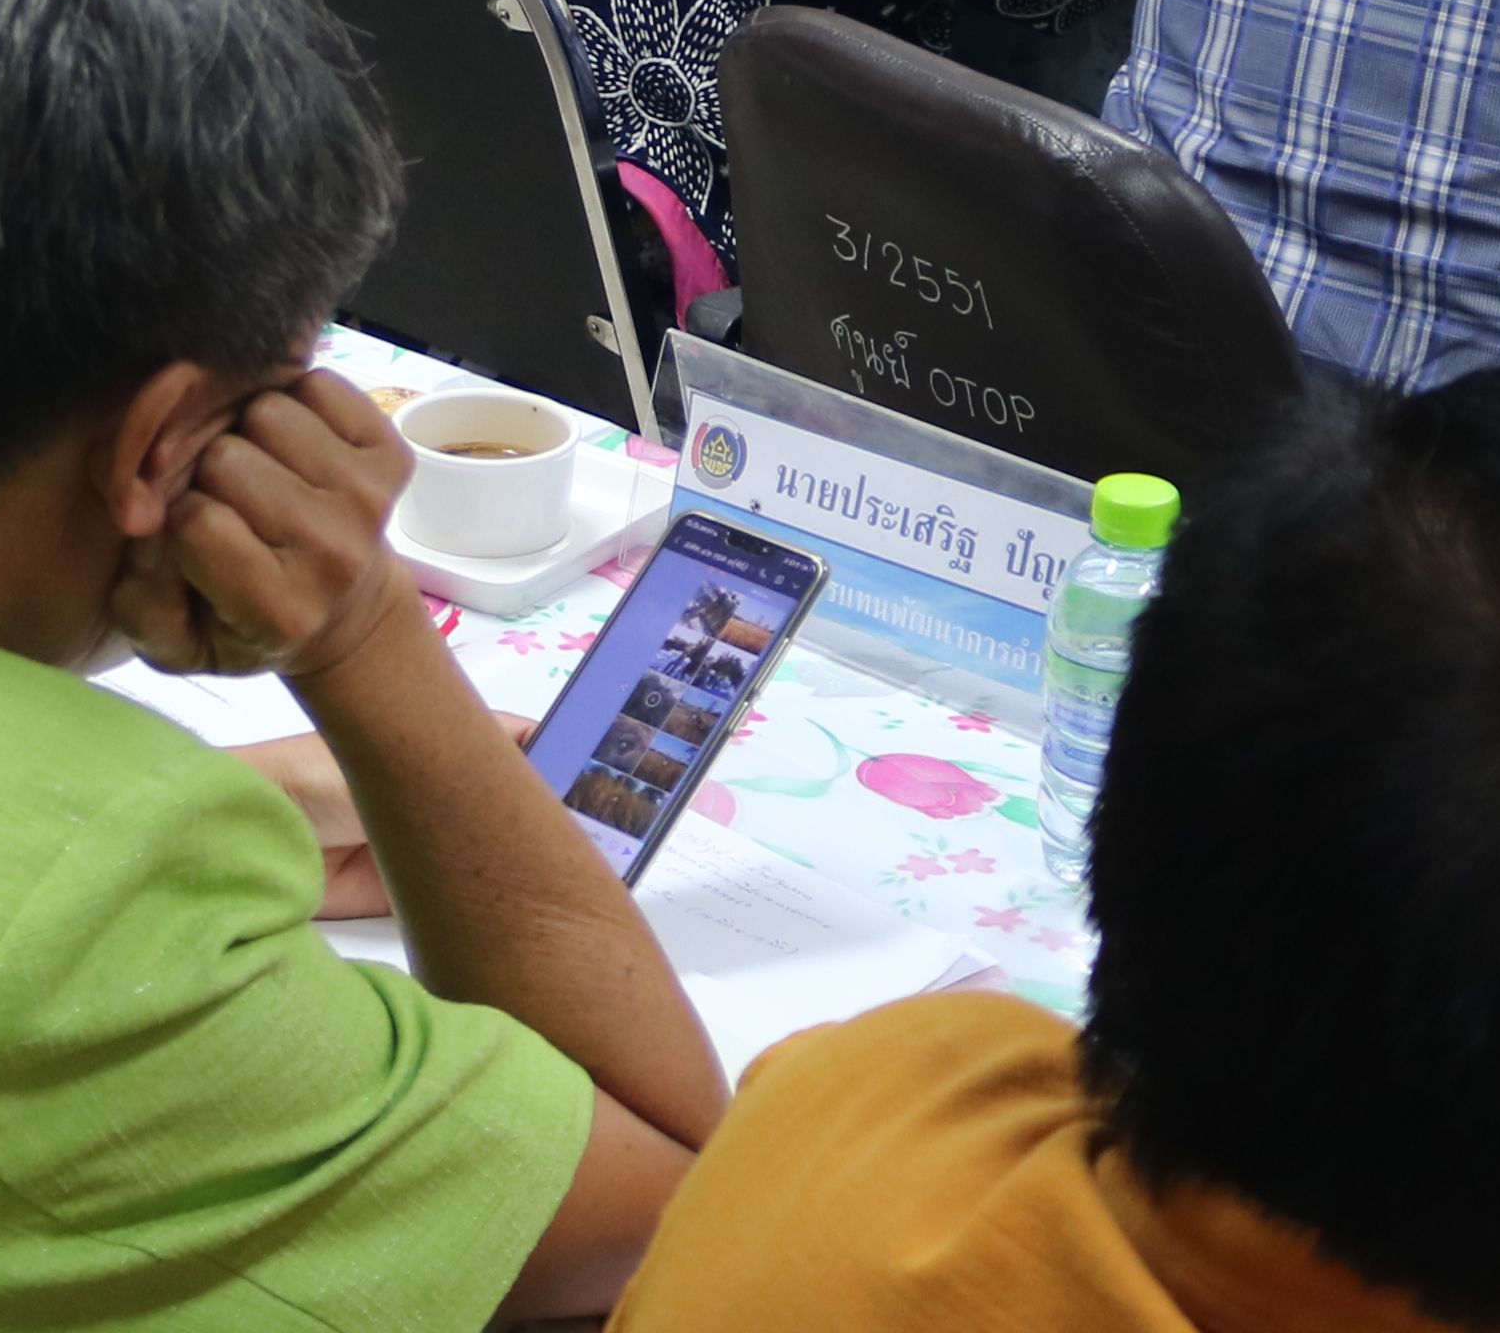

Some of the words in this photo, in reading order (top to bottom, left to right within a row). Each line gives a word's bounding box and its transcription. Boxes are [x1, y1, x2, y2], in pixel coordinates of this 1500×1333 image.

[825, 213, 994, 331] 3/2551
[829, 313, 918, 395] ศูนย์
[929, 367, 1035, 433] OTOP
[776, 462, 981, 575] นายประเสริฐ
